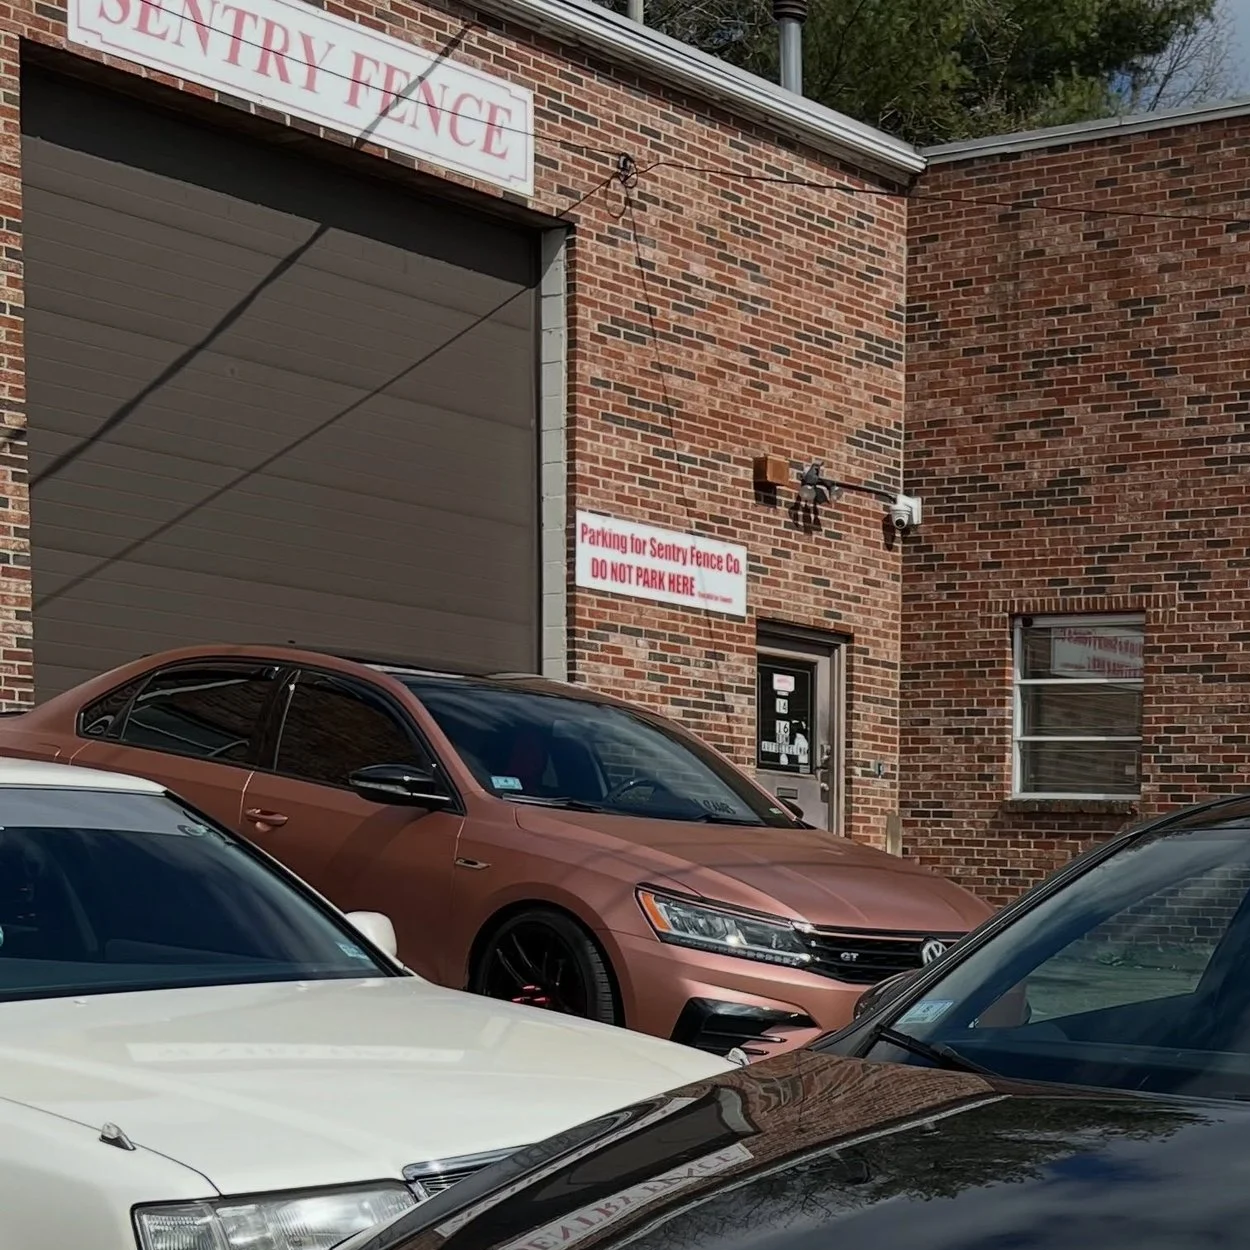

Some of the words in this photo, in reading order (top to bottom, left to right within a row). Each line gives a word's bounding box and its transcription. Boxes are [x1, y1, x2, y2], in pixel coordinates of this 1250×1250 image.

[345, 50, 513, 160] FENCE
[581, 523, 627, 554] Parking
[630, 533, 648, 553] for
[650, 537, 688, 566] Sentry
[690, 546, 723, 572] Fence
[726, 552, 742, 575] Co.
[591, 557, 608, 580] DO
[610, 561, 634, 585] NOT
[636, 566, 665, 592] PARK
[668, 574, 695, 597] HERE
[778, 722, 789, 734] 16
[840, 952, 859, 962] GT
